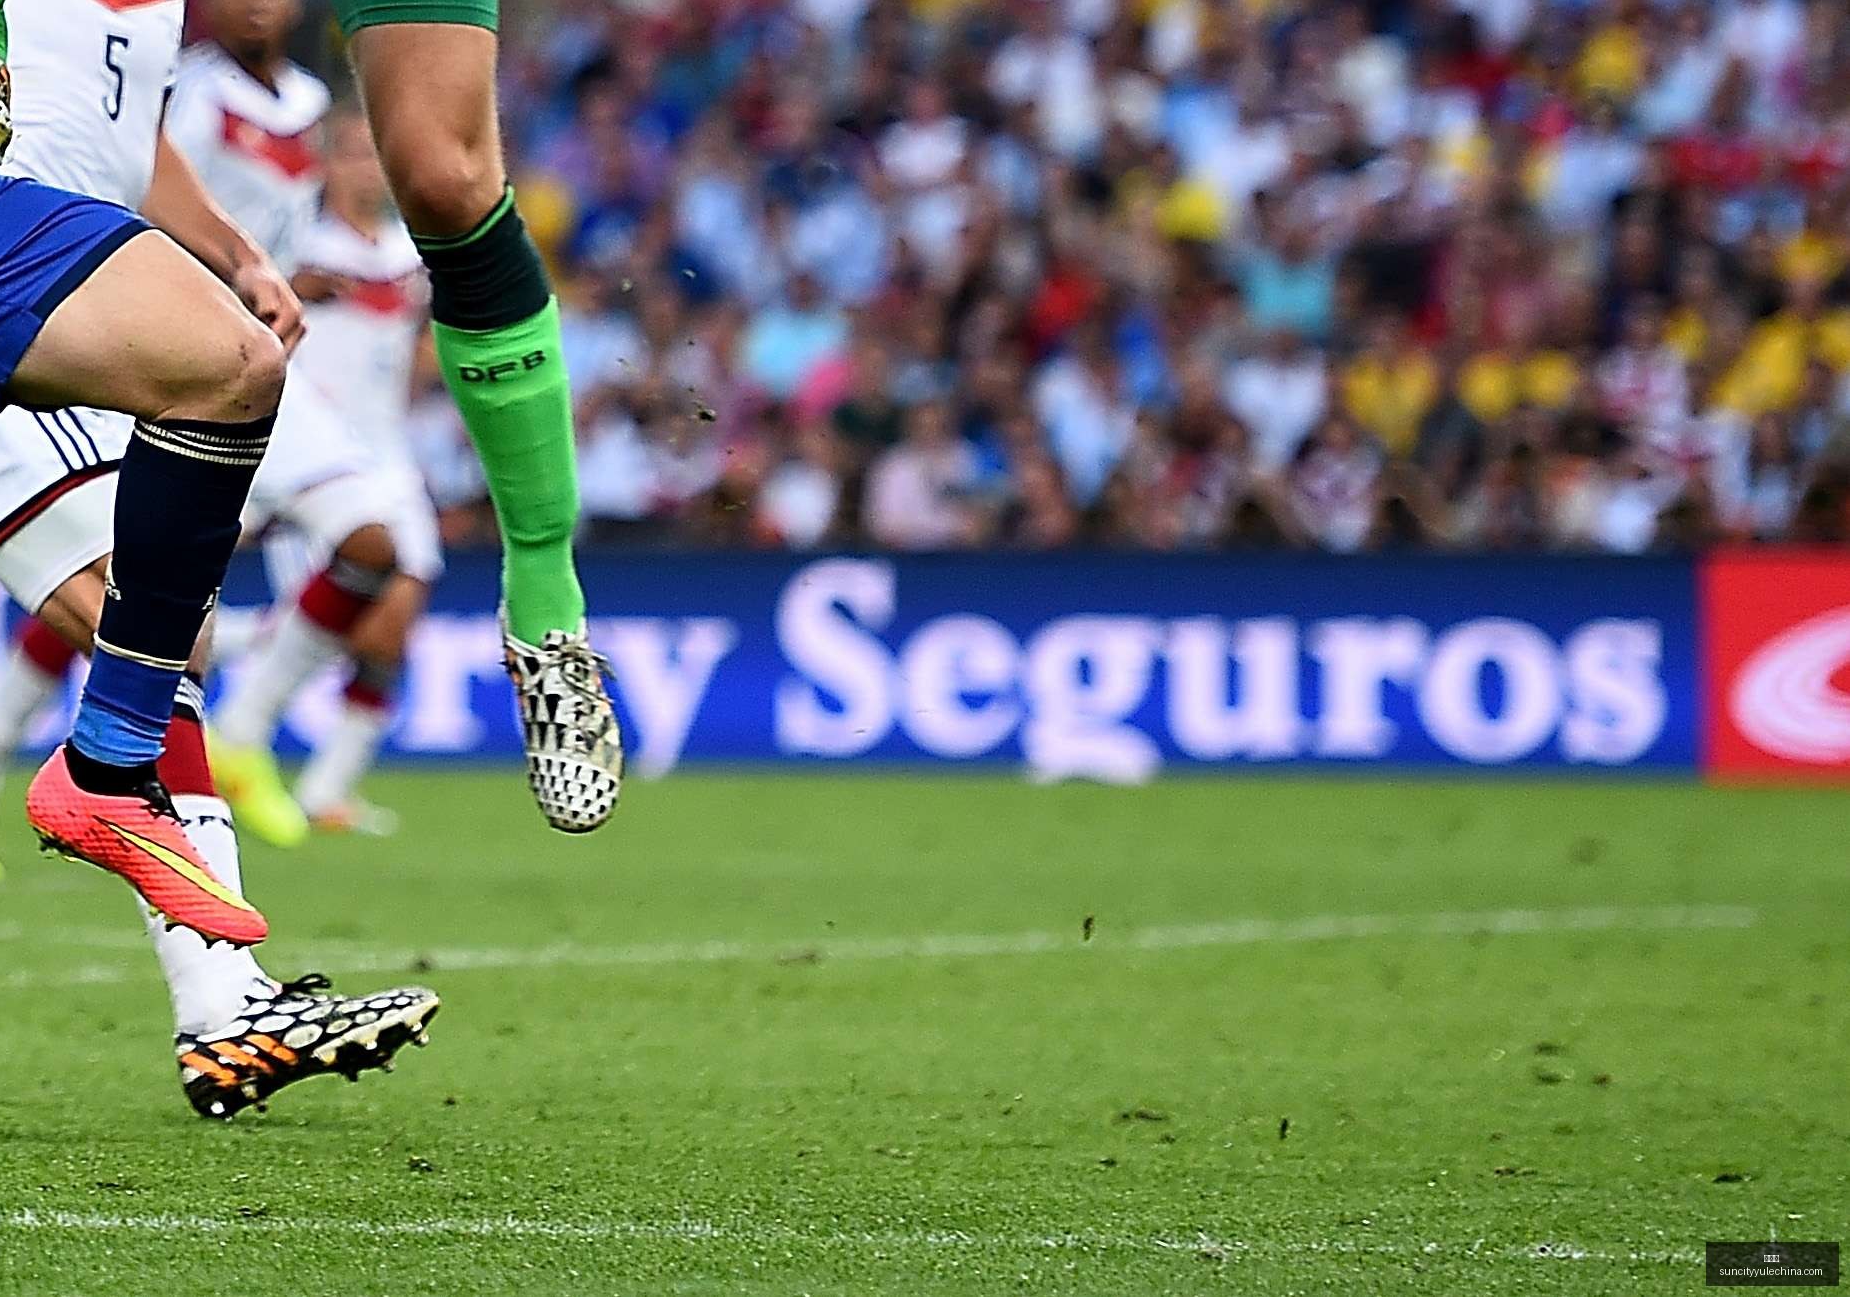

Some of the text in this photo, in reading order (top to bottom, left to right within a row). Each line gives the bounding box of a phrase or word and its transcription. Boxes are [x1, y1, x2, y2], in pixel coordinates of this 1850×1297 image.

[102, 33, 129, 121] 5
[458, 349, 547, 383] DFB
[772, 558, 1667, 783] Seguros
